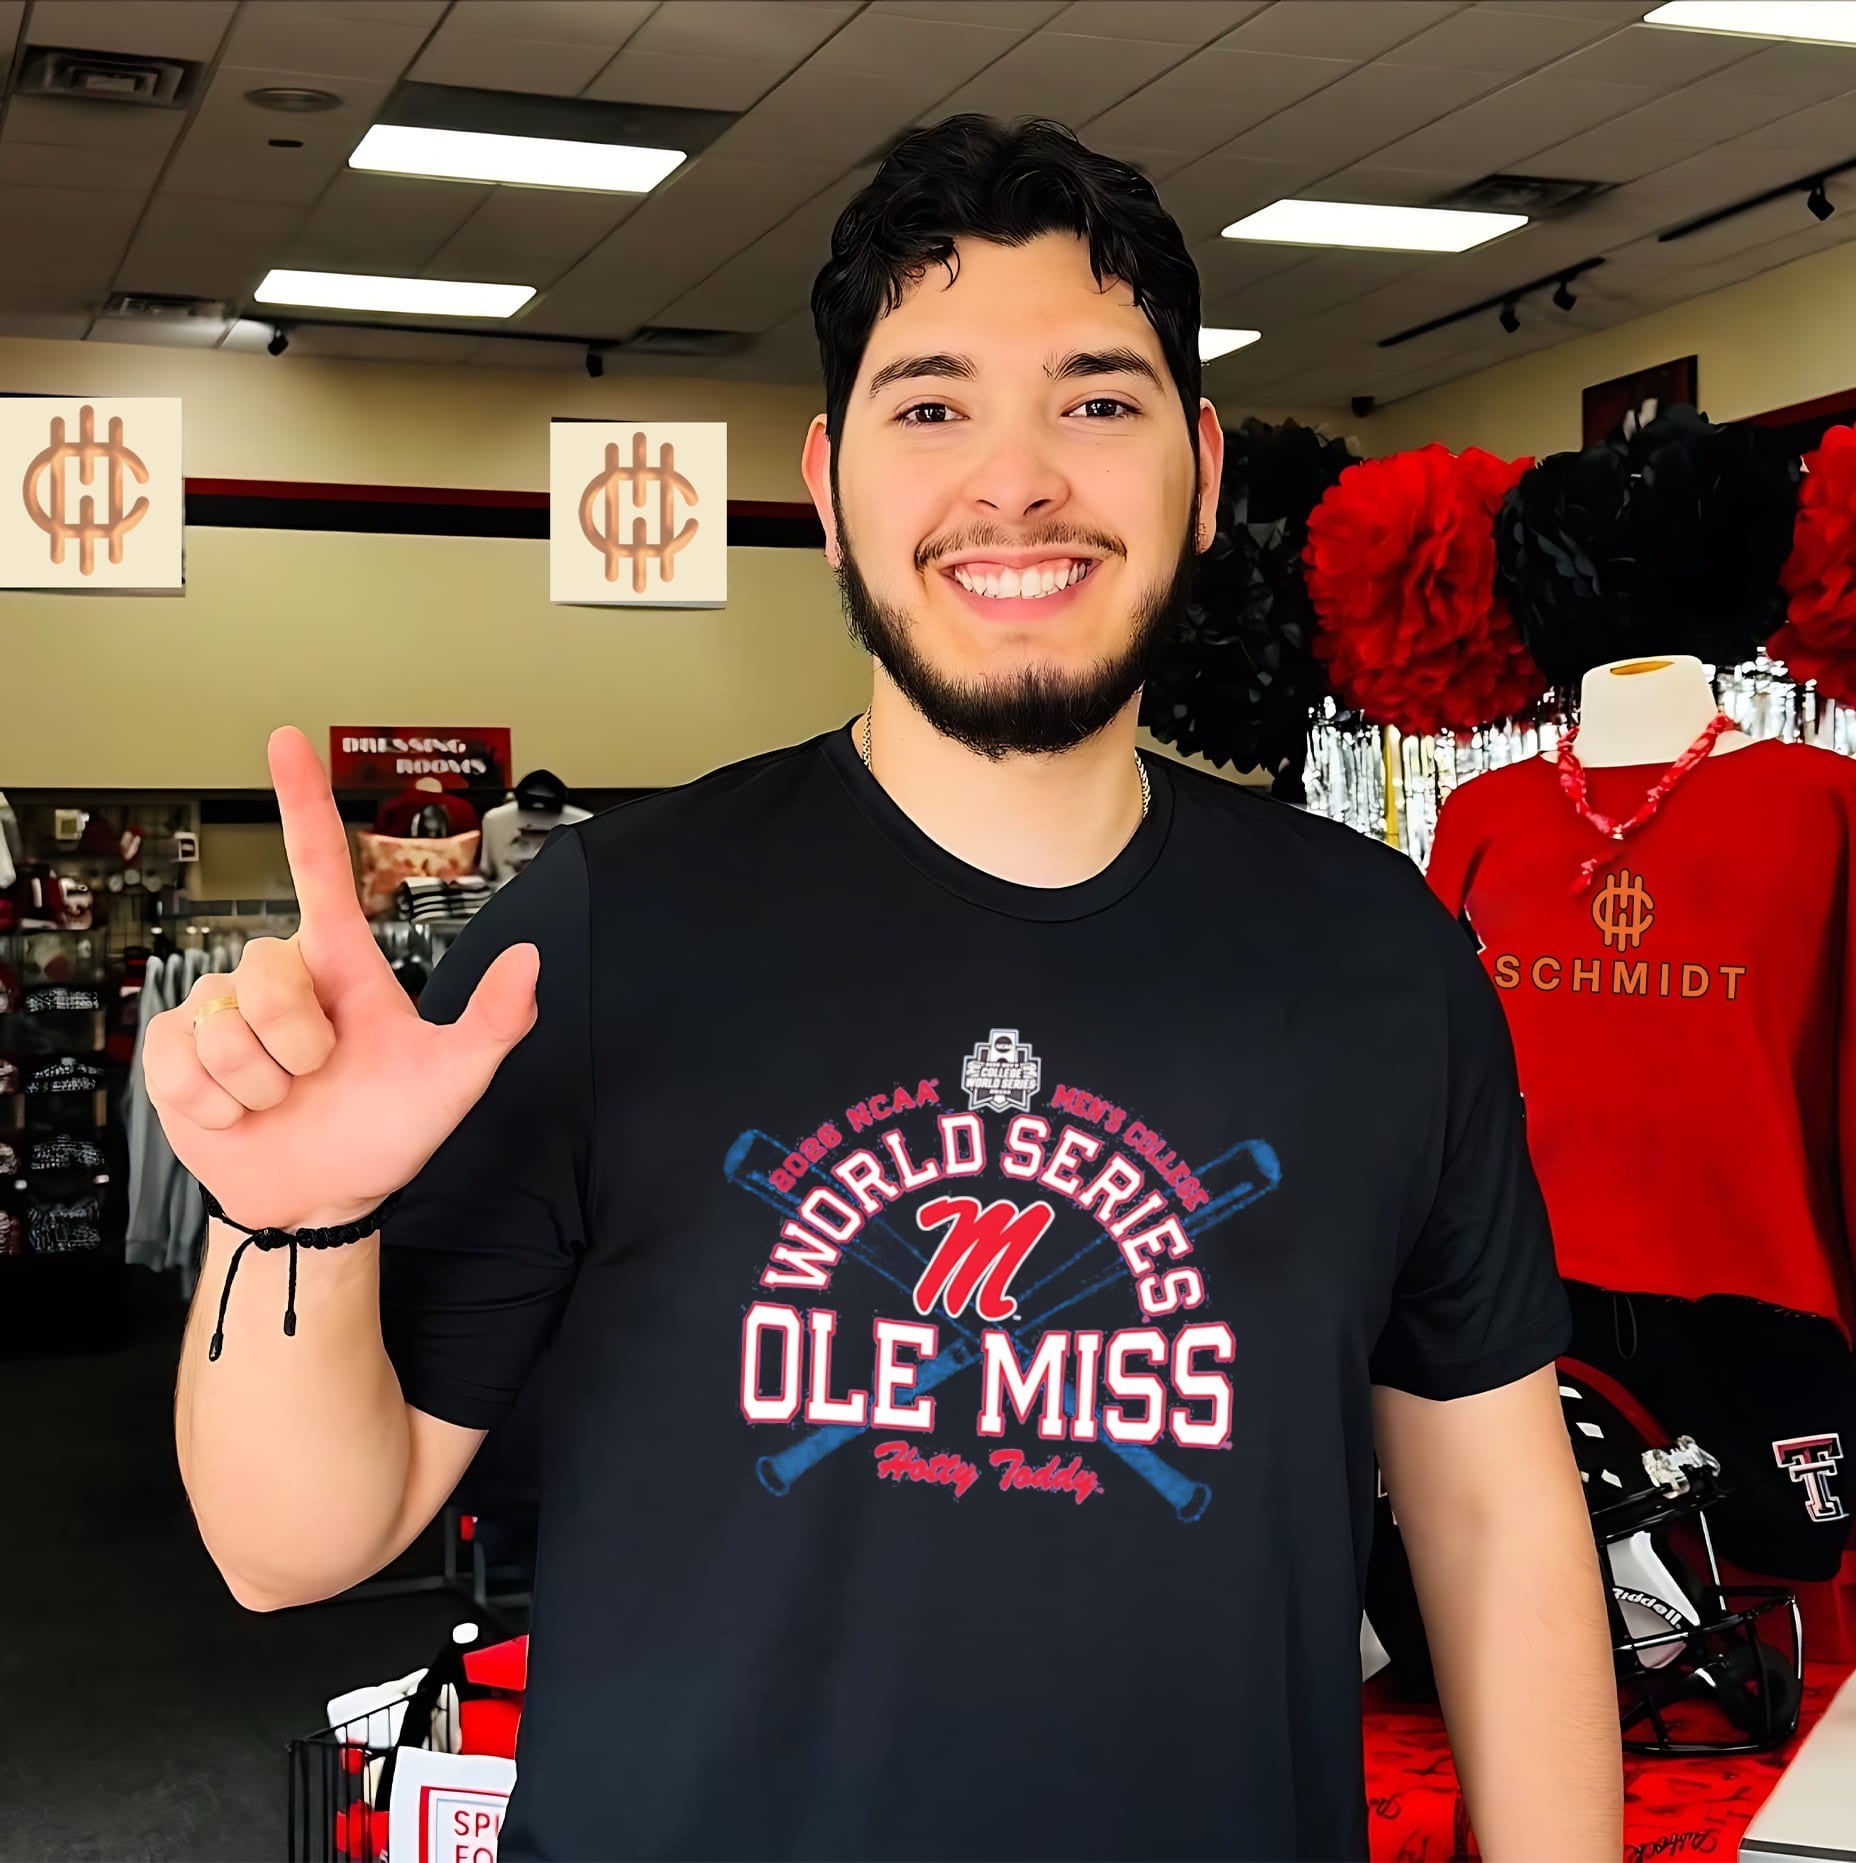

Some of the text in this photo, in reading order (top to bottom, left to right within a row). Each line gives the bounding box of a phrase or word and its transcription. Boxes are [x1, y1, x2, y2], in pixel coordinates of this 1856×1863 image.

[342, 737, 467, 754] DRESSING
[396, 758, 487, 775] ROOMS
[1494, 953, 1747, 1000] SCHMIDT
[965, 1078, 1038, 1091] WORLD SERIES
[980, 1067, 1024, 1079] COLLEGE
[769, 1078, 939, 1193] 2026 NCAA
[1051, 1084, 1210, 1212] MEN'S COLLEGE
[761, 1112, 1205, 1317] WORLD SERIES
[740, 1301, 1237, 1450] OLE MISS
[874, 1440, 1099, 1505] Hotty Toddy
